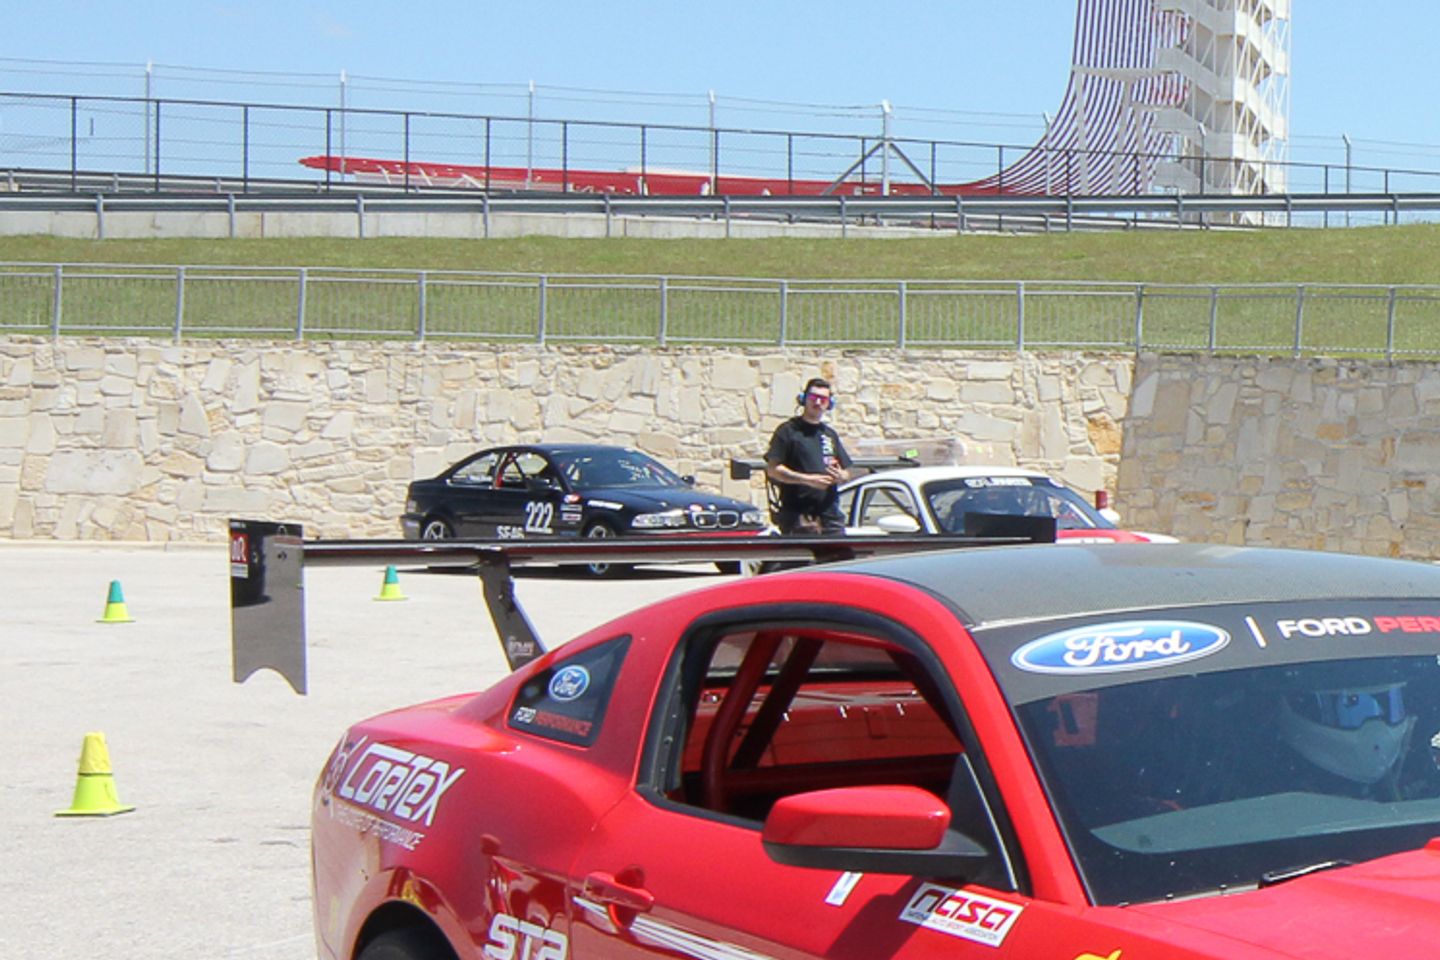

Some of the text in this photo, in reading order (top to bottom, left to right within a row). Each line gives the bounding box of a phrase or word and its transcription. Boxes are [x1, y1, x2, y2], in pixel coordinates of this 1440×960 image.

[525, 501, 554, 535] 222
[1063, 628, 1191, 667] Ford
[1276, 616, 1371, 639] FORD
